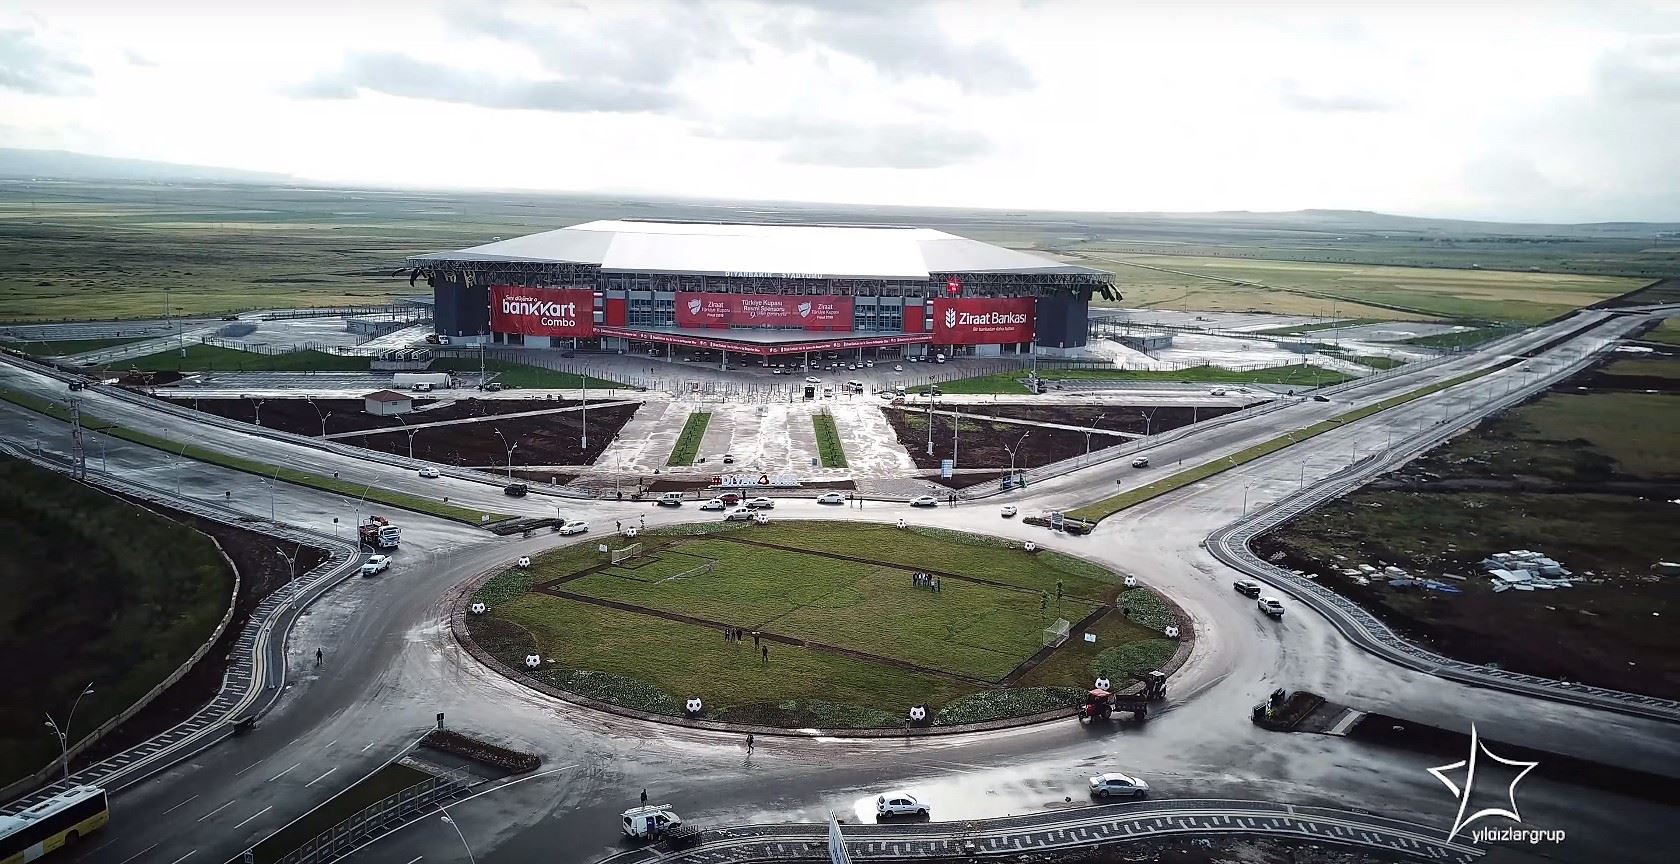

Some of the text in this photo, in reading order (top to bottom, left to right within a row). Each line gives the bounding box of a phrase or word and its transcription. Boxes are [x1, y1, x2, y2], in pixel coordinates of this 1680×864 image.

[541, 317, 576, 327] Combo
[959, 312, 1026, 325] Ziraat Bankası
